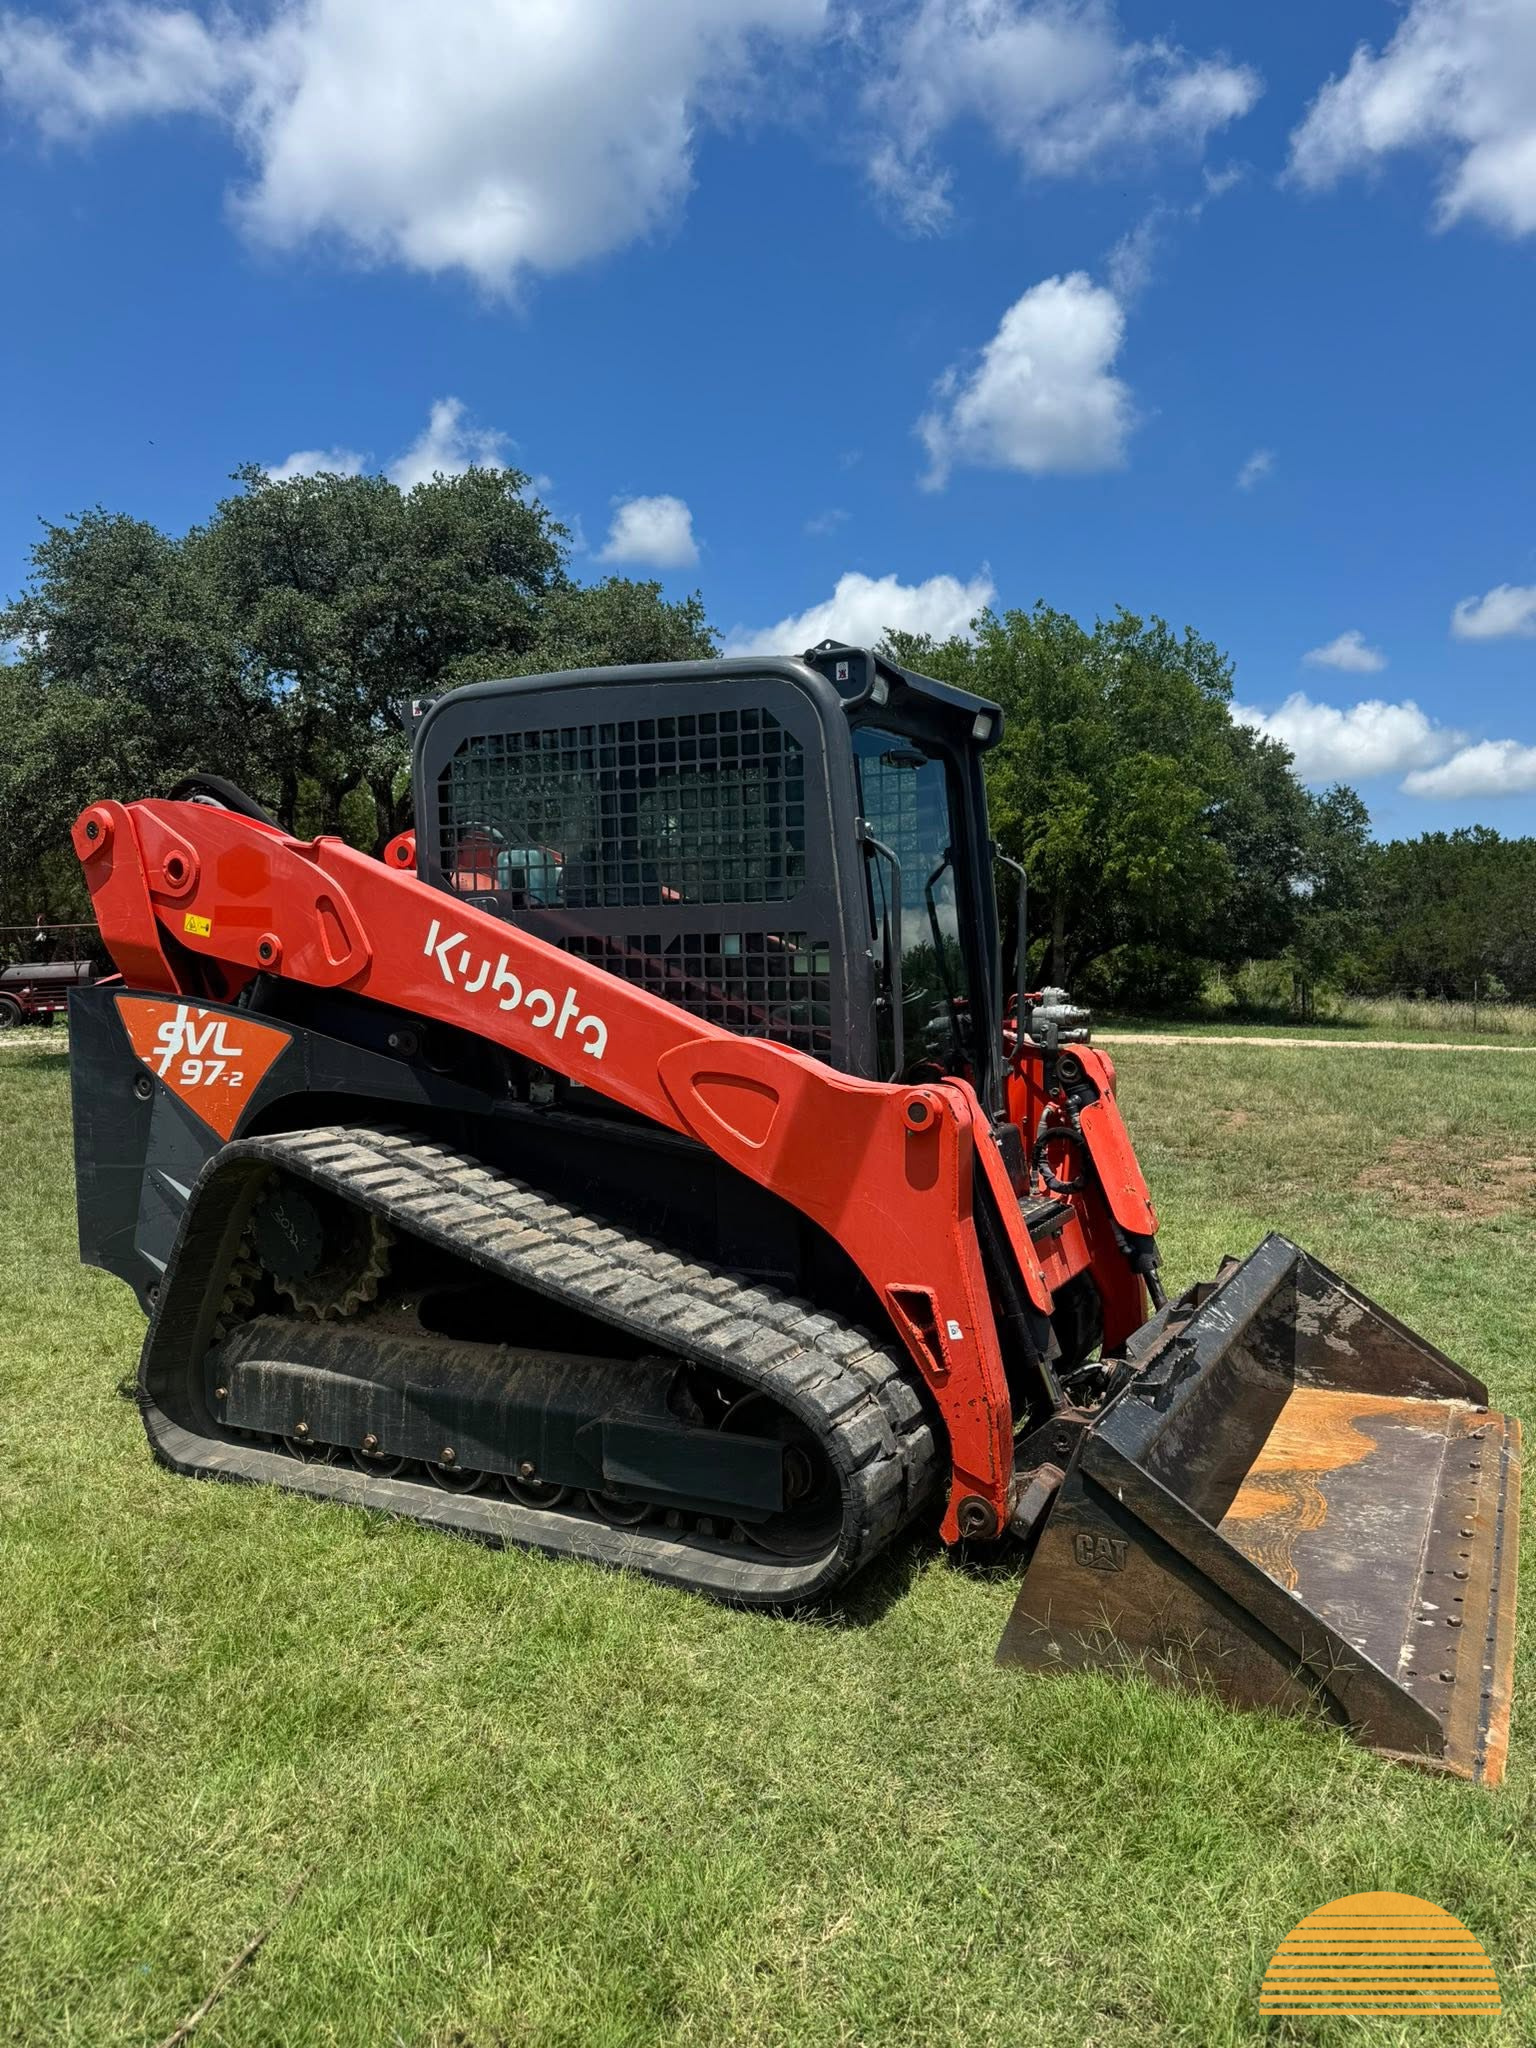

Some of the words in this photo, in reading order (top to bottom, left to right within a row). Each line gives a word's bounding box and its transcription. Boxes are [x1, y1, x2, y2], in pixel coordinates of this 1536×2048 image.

[424, 919, 608, 1059] Kubota
[153, 1021, 243, 1056] SVL
[179, 1059, 245, 1087] 97-2
[1075, 1534, 1129, 1570] CAT
